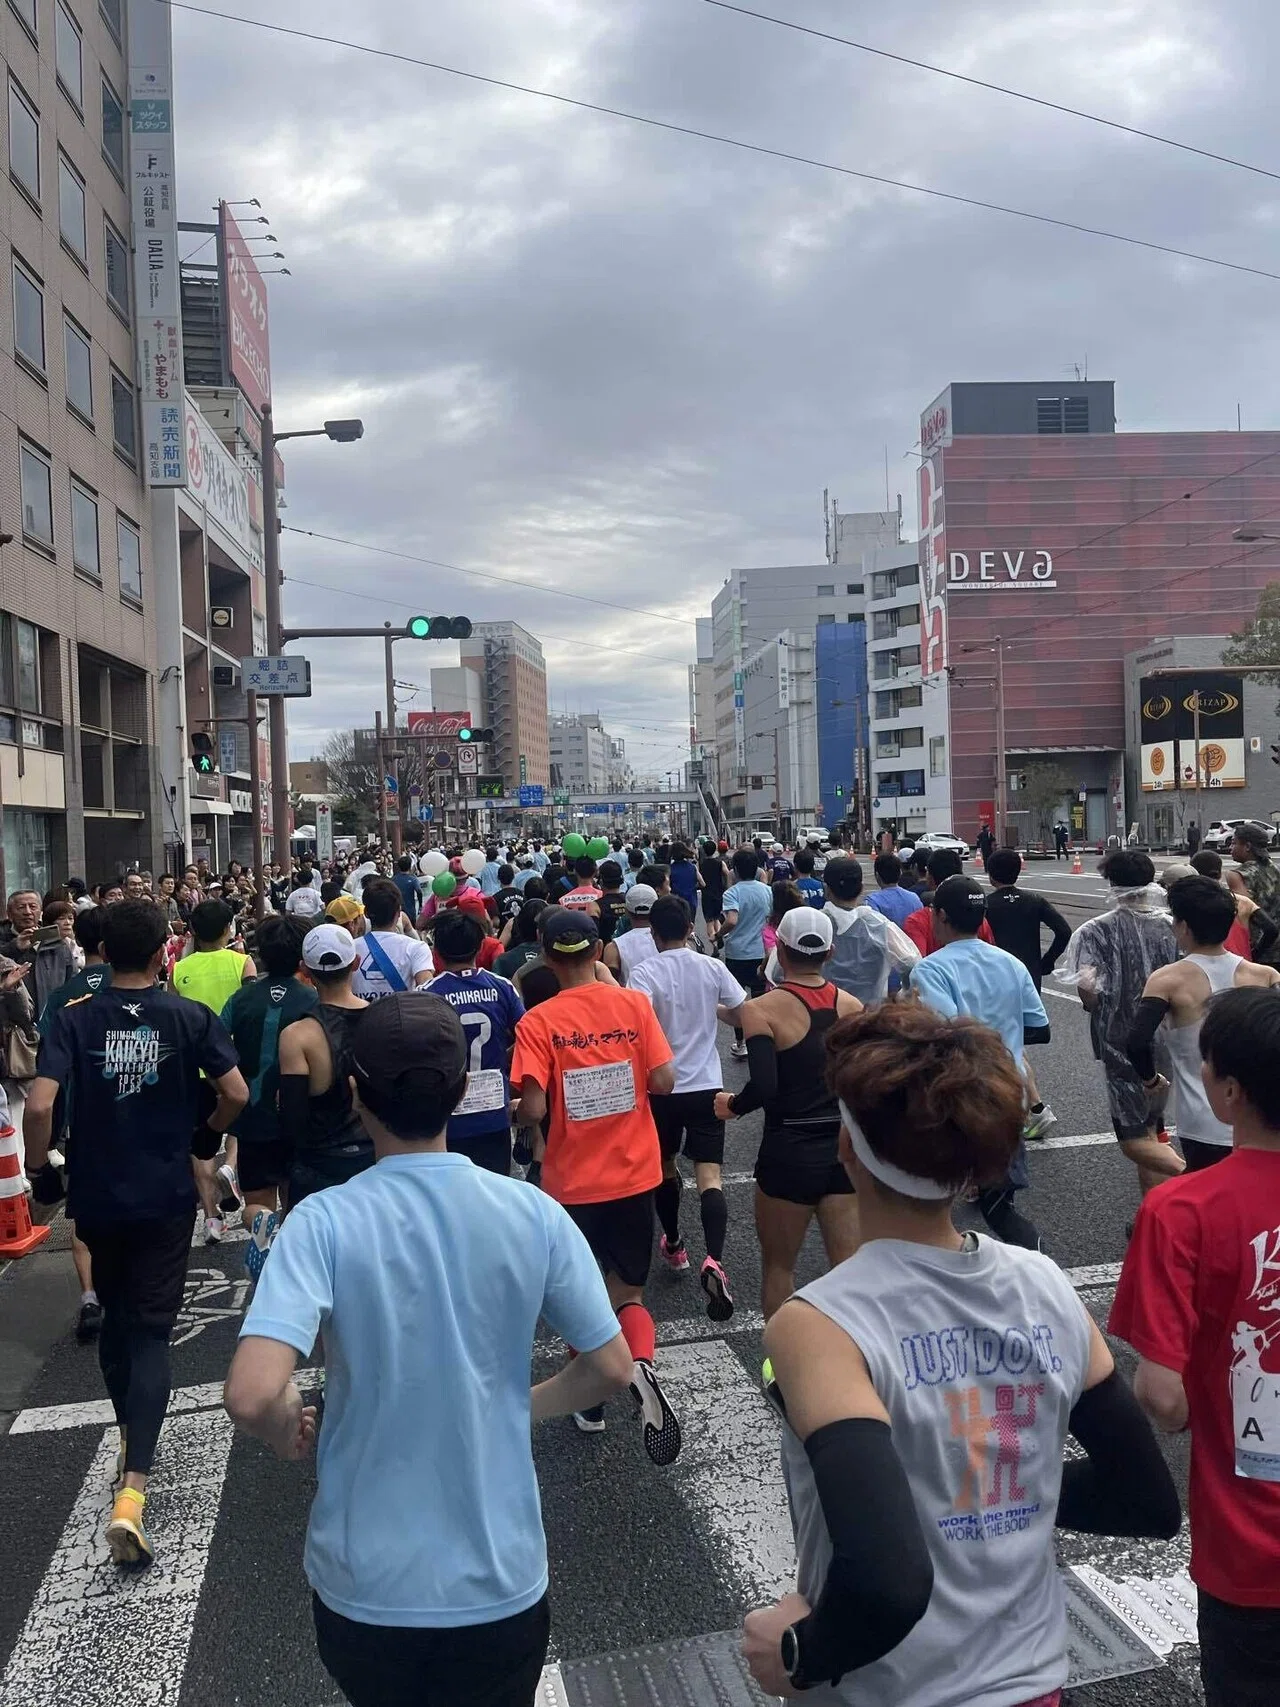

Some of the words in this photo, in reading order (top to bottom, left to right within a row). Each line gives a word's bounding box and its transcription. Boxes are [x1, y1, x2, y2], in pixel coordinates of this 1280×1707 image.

[136, 121, 167, 129] スタッフ
[143, 185, 156, 229] 公証役場
[148, 240, 164, 271] DALIA
[154, 353, 168, 399] やまもも
[160, 407, 181, 479] 読売新聞
[258, 659, 289, 671] 堀詰
[248, 672, 299, 684] 交差点
[106, 1031, 159, 1041] SHIMONOSEKI
[105, 1040, 159, 1062] KAIKYO
[105, 1062, 158, 1073] MARATHON
[119, 1074, 142, 1085] 2023
[900, 1326, 968, 1391] JUST
[973, 1327, 1033, 1375] DO
[1242, 1417, 1265, 1442] A
[937, 1515, 978, 1528] work
[983, 1511, 1002, 1524] the
[1005, 1503, 1040, 1518] mind
[944, 1526, 984, 1541] WORK
[986, 1521, 1003, 1538] THE
